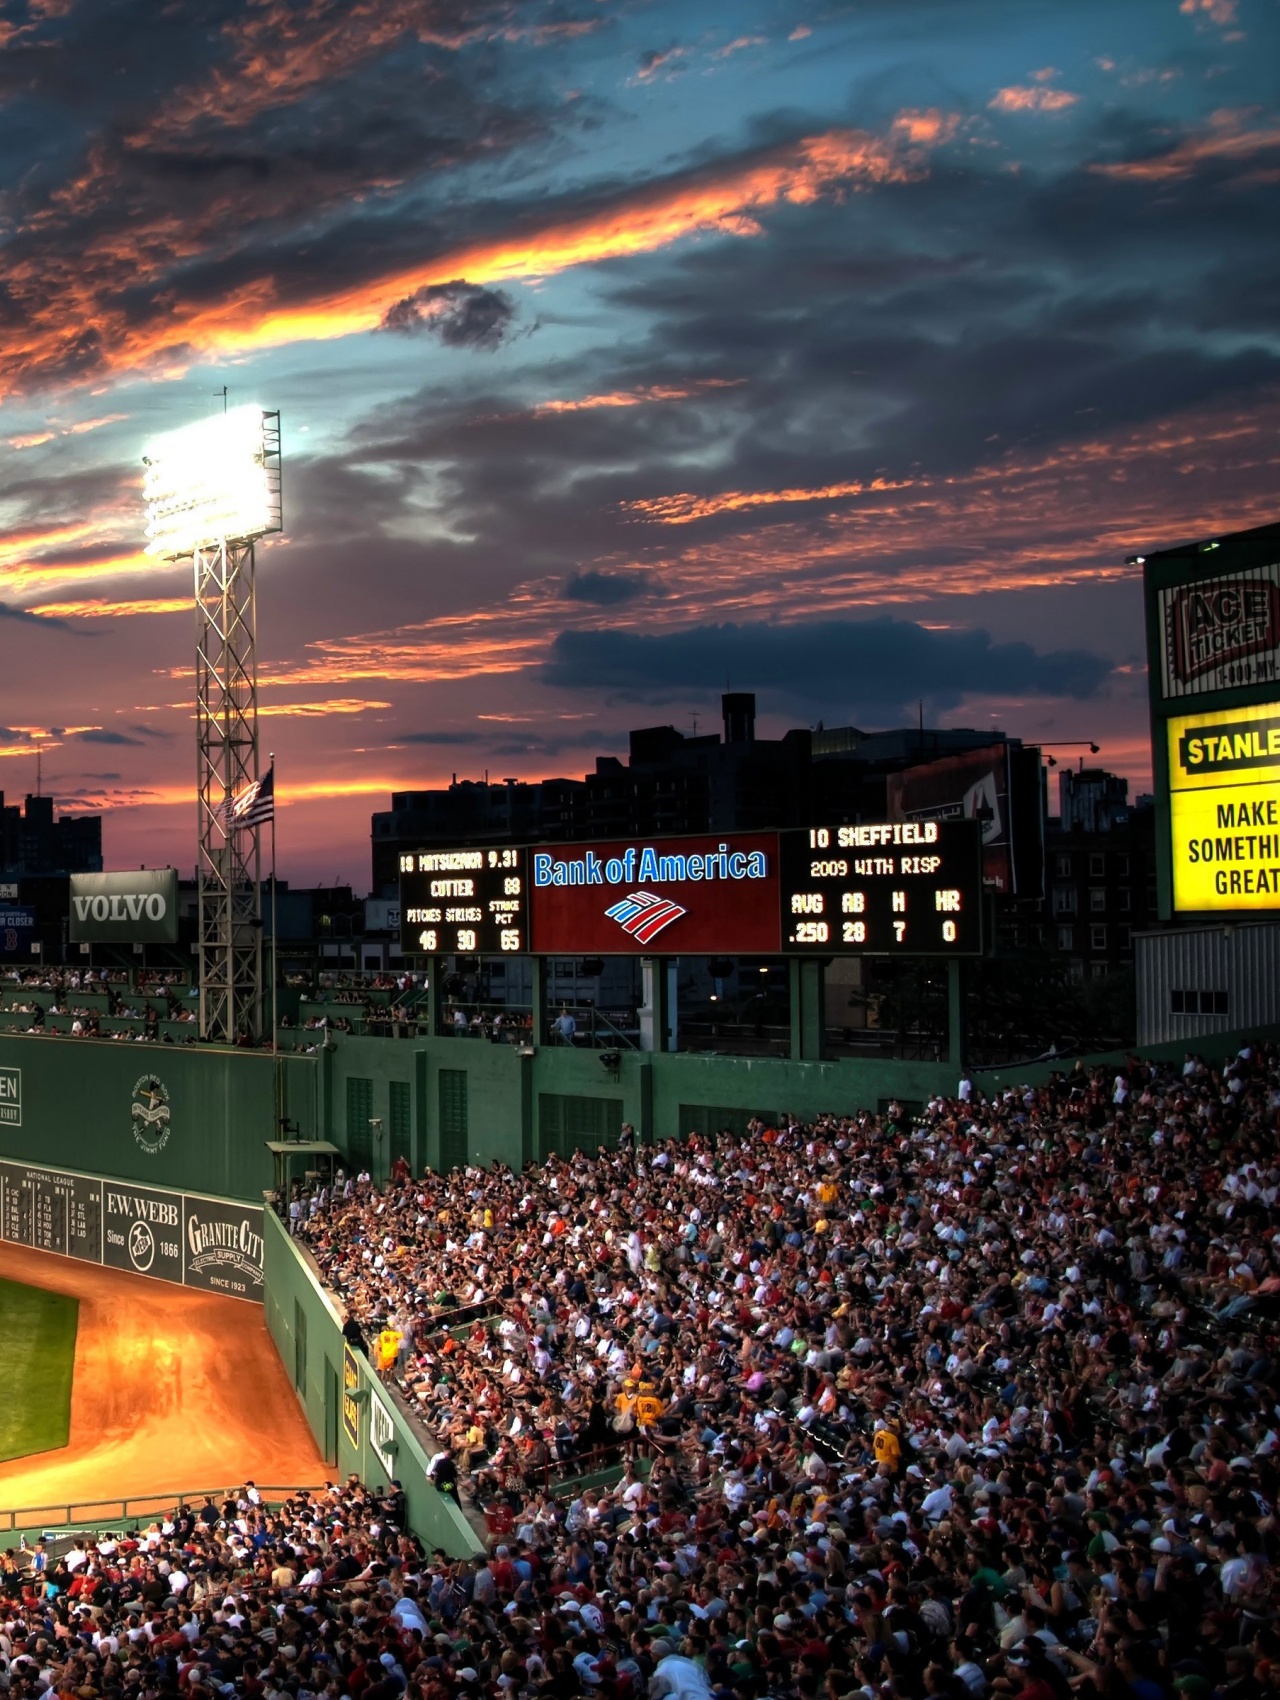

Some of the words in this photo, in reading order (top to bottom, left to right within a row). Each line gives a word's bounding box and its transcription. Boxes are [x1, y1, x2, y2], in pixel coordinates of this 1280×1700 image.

[1189, 587, 1269, 637] ACE
[1190, 621, 1268, 664] TICKET
[1217, 800, 1278, 829] MAKE
[809, 828, 829, 848] 10
[837, 822, 937, 847] SHEFFIELD
[419, 852, 482, 872] MATSUZAKA
[488, 850, 517, 868] 9.31
[534, 851, 602, 887] Bank
[605, 848, 636, 884] of
[638, 844, 766, 883] America
[810, 861, 848, 877] 2009
[855, 859, 894, 875] WITH
[901, 856, 941, 874] RISP
[430, 879, 474, 897] CUTTER
[1215, 868, 1280, 895] GREAT
[72, 894, 167, 922] VOLVO
[489, 900, 519, 911] STRIKE
[791, 893, 823, 914] AVG
[842, 892, 865, 913] AB
[892, 891, 905, 912] H
[935, 889, 960, 912] HR
[7, 918, 35, 926] CLOSER
[407, 908, 441, 923] PITCHES
[445, 908, 481, 922] STRIKES
[495, 913, 513, 925] PCT
[4, 928, 18, 950] B
[419, 930, 436, 950] 46
[457, 929, 475, 950] 30
[500, 929, 519, 950] 65
[789, 921, 829, 942] .250
[842, 921, 865, 942] 28
[893, 921, 906, 942] 7
[942, 920, 956, 942] 0
[132, 1074, 149, 1098] BOSTON
[150, 1074, 160, 1085] RED
[160, 1083, 170, 1102] SOX
[132, 1122, 141, 1144] THE
[140, 1143, 158, 1154] JIMMY
[159, 1128, 171, 1150] FUND
[26, 1171, 52, 1182] NATIONAL
[53, 1176, 74, 1187] LEAGUE
[11, 1188, 19, 1197] CHC
[44, 1204, 52, 1212] FLA
[44, 1212, 52, 1221] TEX
[78, 1212, 86, 1220] STL
[107, 1193, 133, 1218] F.W.
[134, 1198, 178, 1226] WEBB
[11, 1223, 19, 1232] CLE
[43, 1222, 52, 1230] HOU
[78, 1220, 86, 1229] LAA
[78, 1229, 86, 1238] LAD
[44, 1230, 52, 1238] TOR
[188, 1214, 238, 1256] GRANITE
[240, 1220, 264, 1270] CITY
[44, 1239, 52, 1248] ATL
[107, 1229, 125, 1247] Since
[160, 1241, 178, 1258] 1866
[195, 1254, 216, 1268] ELECTRIC
[216, 1250, 242, 1264] SUPPLY
[242, 1262, 262, 1280] COMPANY
[210, 1276, 229, 1288] SINCE
[231, 1280, 246, 1292] 1923
